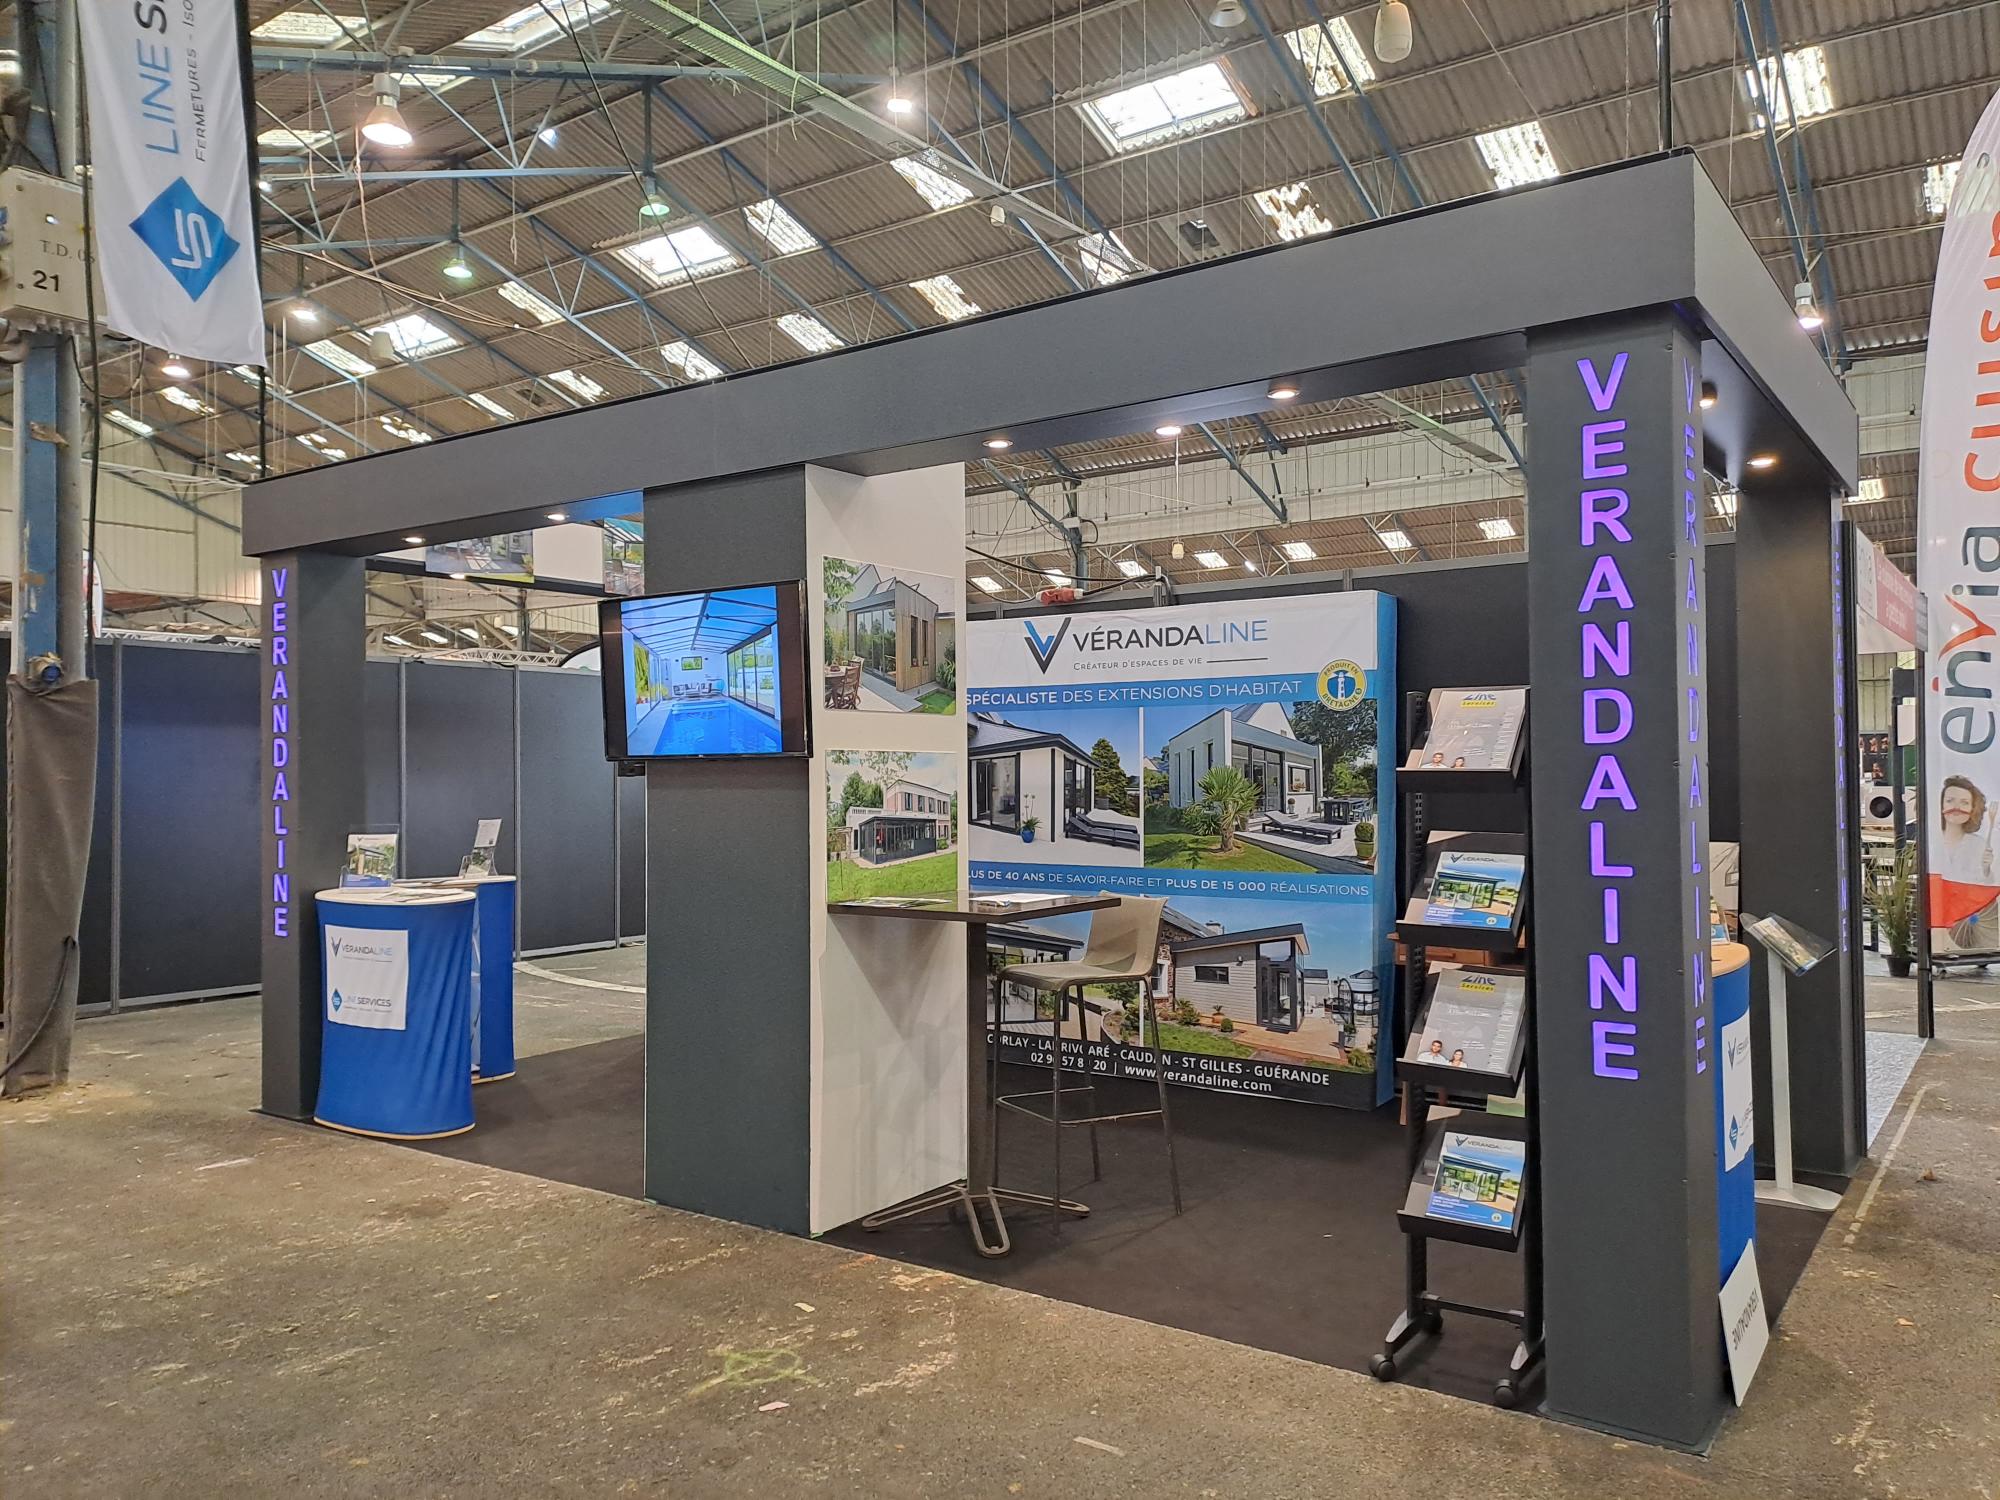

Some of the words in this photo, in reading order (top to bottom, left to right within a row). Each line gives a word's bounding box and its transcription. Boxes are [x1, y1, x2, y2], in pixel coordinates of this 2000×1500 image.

[185, 47, 207, 163] FERMETURES
[32, 269, 60, 292] 21
[1172, 658, 1185, 666] DE
[1188, 657, 1203, 665] VIE
[966, 690, 1058, 706] SPÉCIALISTE
[1062, 690, 1093, 703] DES
[1098, 685, 1203, 702] EXTENSIONS
[1209, 680, 1303, 698] D'HABITAT
[1322, 693, 1358, 708] BRETAGNE
[1576, 351, 1640, 1081] VERANDALINE
[1683, 357, 1706, 1075] VERANDALINE
[270, 567, 290, 938] VERANDALINE
[988, 871, 1002, 880] DE
[1005, 872, 1019, 881] 40
[1023, 872, 1046, 882] ANS
[1048, 873, 1063, 883] DE
[1066, 874, 1144, 887] SAVOIR-FAIRE
[1147, 878, 1162, 887] ET
[1166, 878, 1197, 889] PLUS
[1201, 880, 1218, 889] DE
[1222, 881, 1234, 890] 15
[1238, 881, 1266, 892] 000
[1270, 881, 1369, 896] RÉALISATIONS
[987, 1033, 1029, 1048] CRLAY
[1120, 1050, 1171, 1065] CAUDN
[1182, 1056, 1196, 1069] ST
[1200, 1059, 1243, 1074] GILLES
[1254, 1064, 1331, 1086] GUÉRANDE
[1031, 1052, 1043, 1063] 02
[1061, 1056, 1075, 1067] 57
[1093, 1060, 1107, 1071] 20
